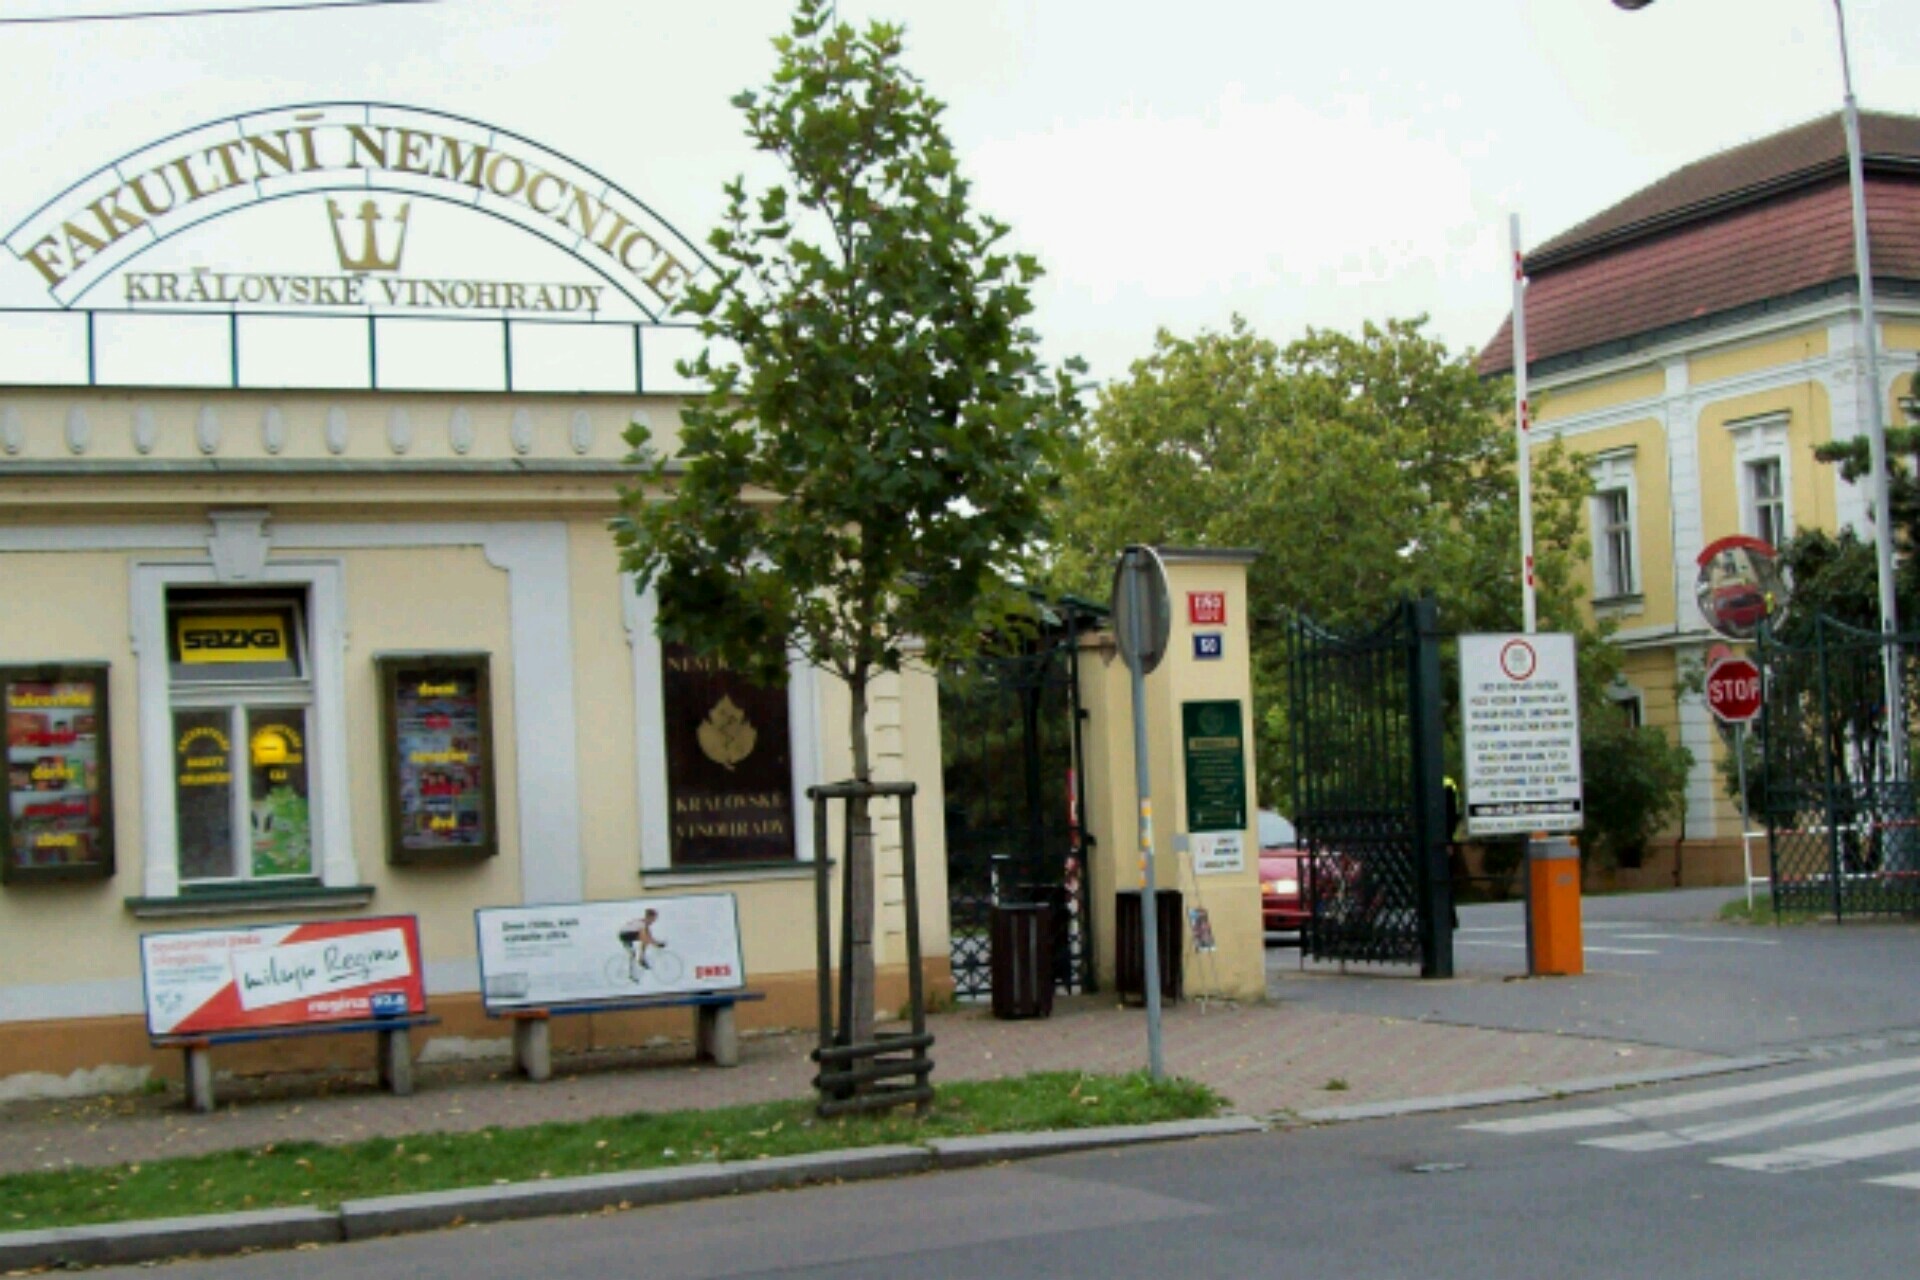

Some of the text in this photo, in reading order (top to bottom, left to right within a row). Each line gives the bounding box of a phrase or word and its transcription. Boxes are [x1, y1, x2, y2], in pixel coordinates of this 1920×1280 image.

[23, 113, 694, 304] FAKULTNÍ NEMOCNICE
[380, 279, 604, 311] VINOHRADY
[1710, 677, 1760, 702] STOP
